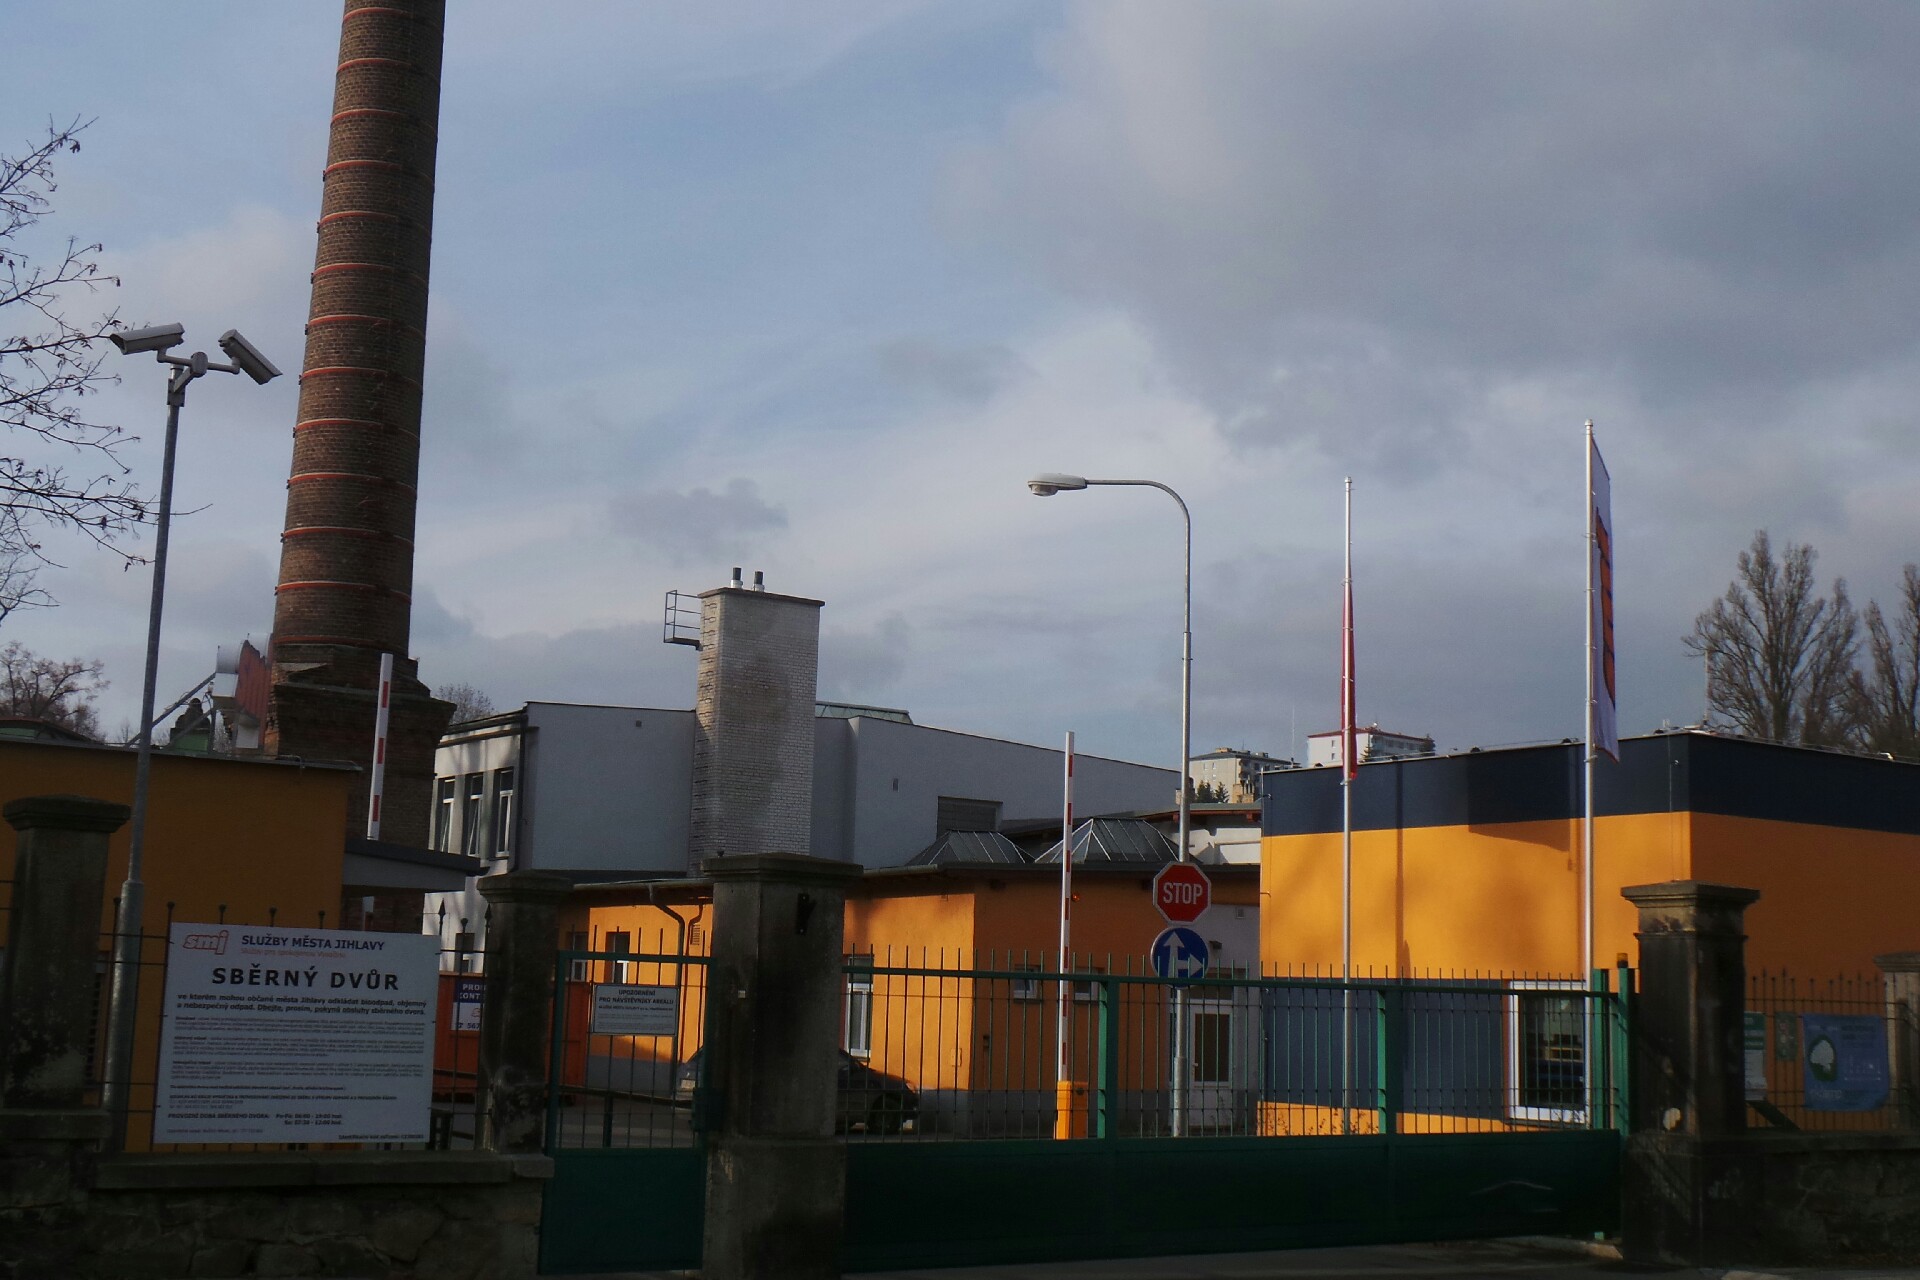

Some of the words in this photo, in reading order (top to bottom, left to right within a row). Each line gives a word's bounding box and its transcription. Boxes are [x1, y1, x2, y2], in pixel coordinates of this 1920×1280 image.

[1163, 882, 1203, 905] STOP
[241, 933, 288, 947] SLUŽBY
[292, 934, 332, 949] MĚSTA
[334, 938, 385, 951] JIHLAVY
[212, 963, 318, 988] SBĚRNÝ
[330, 968, 399, 991] DVŮR
[183, 1001, 228, 1011] nebezpečný
[230, 1002, 256, 1011] odpad.
[257, 1004, 284, 1013] Dbejte,
[285, 1004, 313, 1013] prosím,
[314, 1005, 341, 1014] pokynů
[342, 1006, 370, 1015] obsluhy
[371, 1007, 403, 1016] sběrného
[189, 992, 217, 1001] kterém
[219, 993, 245, 1002] mohou
[247, 994, 274, 1003] občané
[276, 995, 299, 1004] města
[301, 997, 326, 1006] Jihlavy
[327, 998, 359, 1006] odkládat
[397, 1000, 427, 1009] objemný
